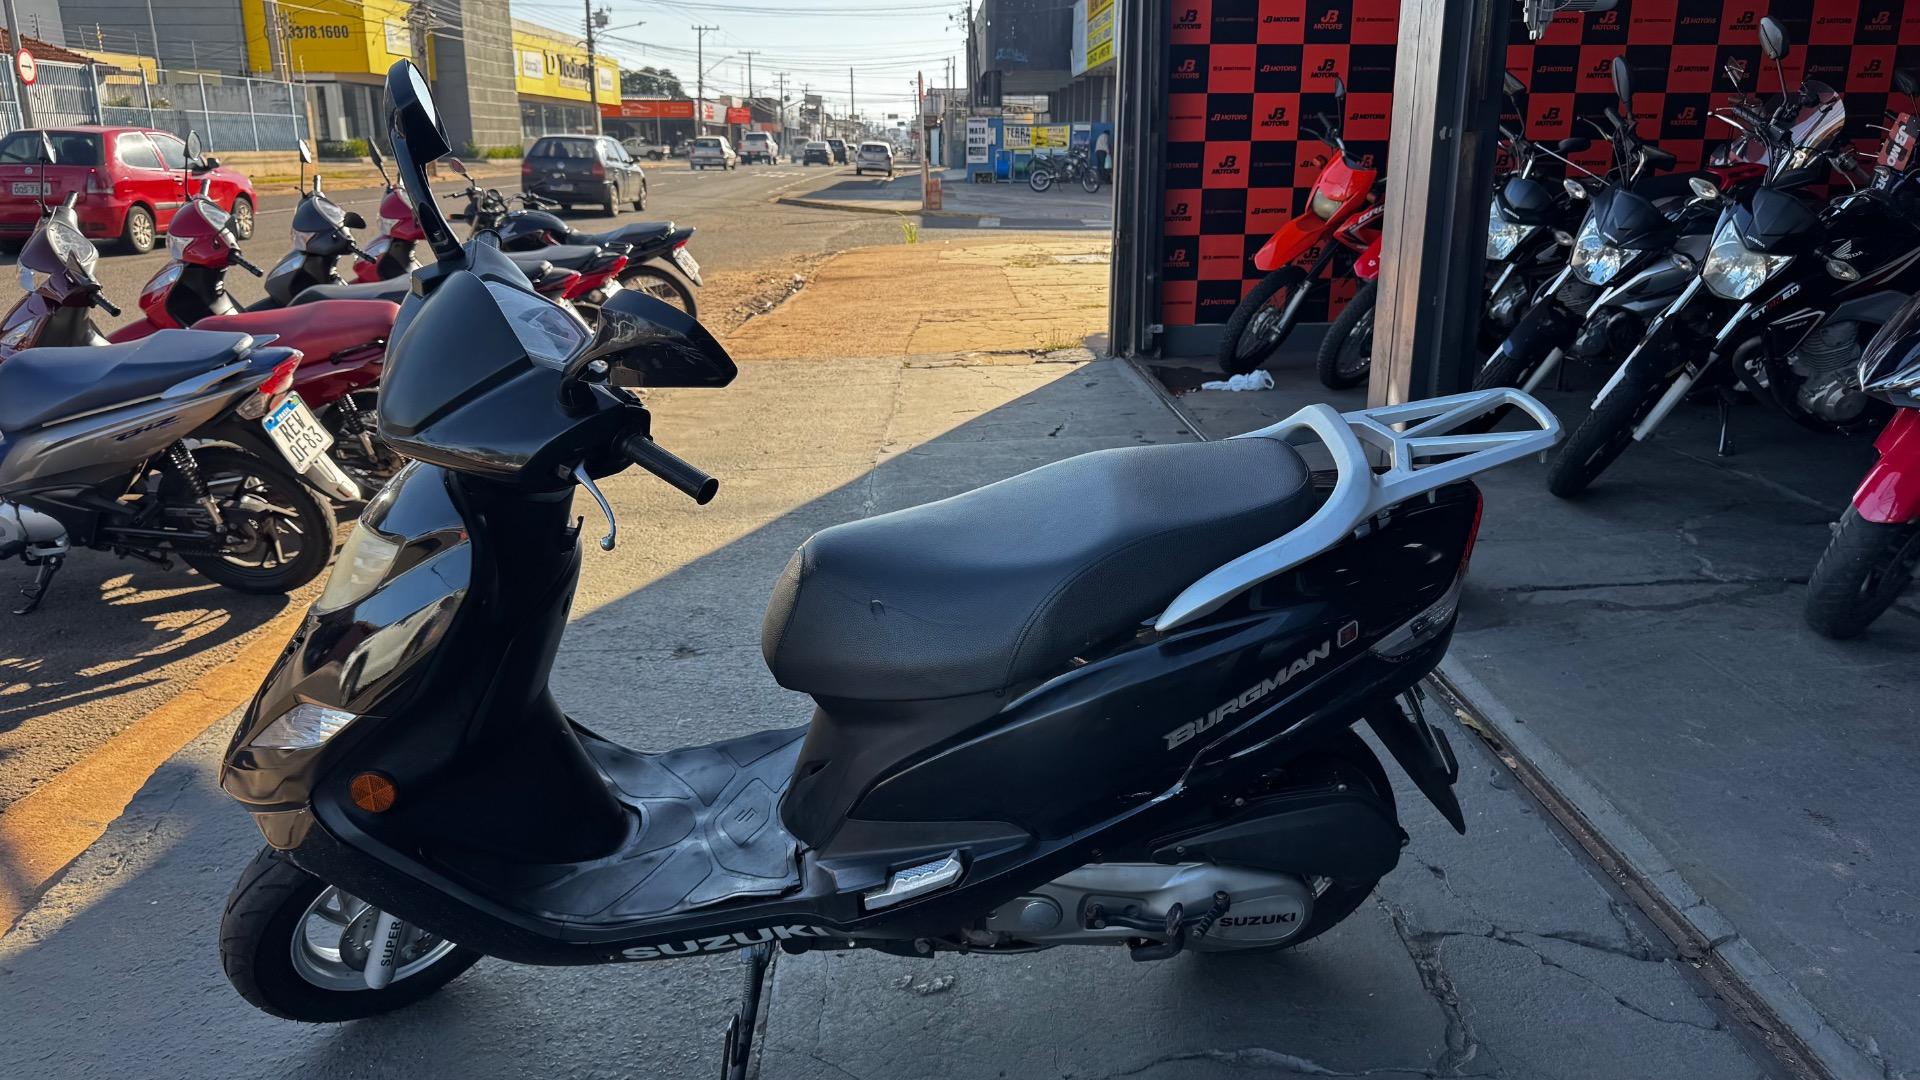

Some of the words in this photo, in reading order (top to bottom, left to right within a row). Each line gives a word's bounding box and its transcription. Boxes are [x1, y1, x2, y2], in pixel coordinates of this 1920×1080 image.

[1162, 640, 1330, 750] BURGMAN
[1219, 912, 1296, 927] SUZUKI
[381, 921, 401, 967] SUPER
[622, 924, 830, 959] SUZUKI
